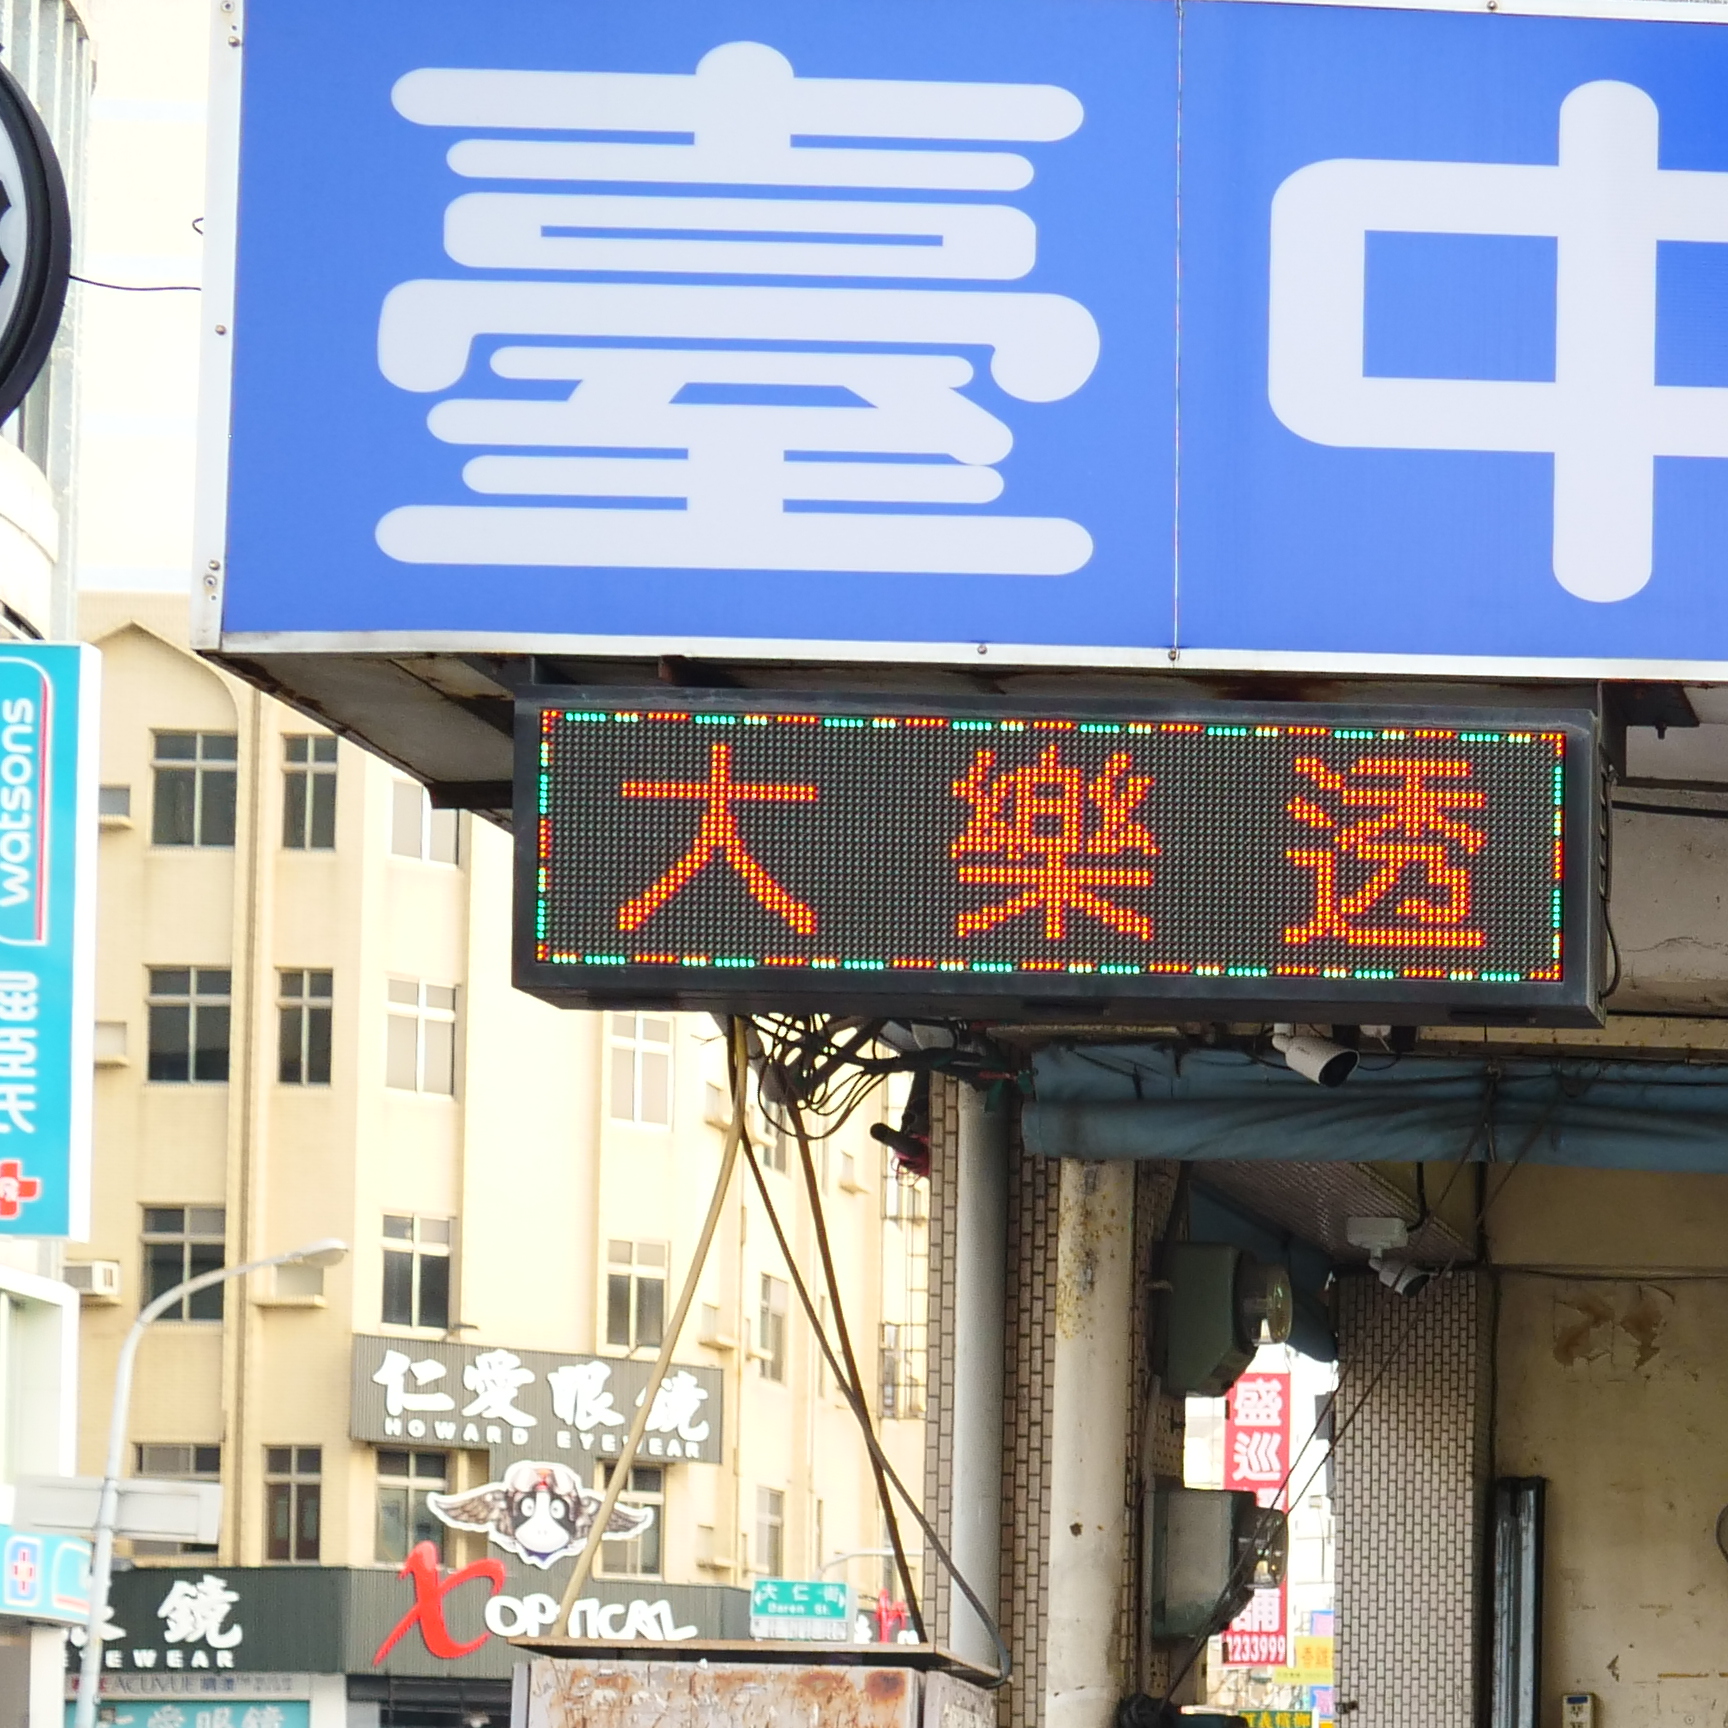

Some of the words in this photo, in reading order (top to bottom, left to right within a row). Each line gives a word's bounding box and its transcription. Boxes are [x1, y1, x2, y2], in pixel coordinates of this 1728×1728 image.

[0, 697, 34, 907] watsons
[618, 743, 1486, 950] 大樂透
[373, 1349, 709, 1442] 仁愛眼鏡
[384, 1417, 529, 1446] HOWARD
